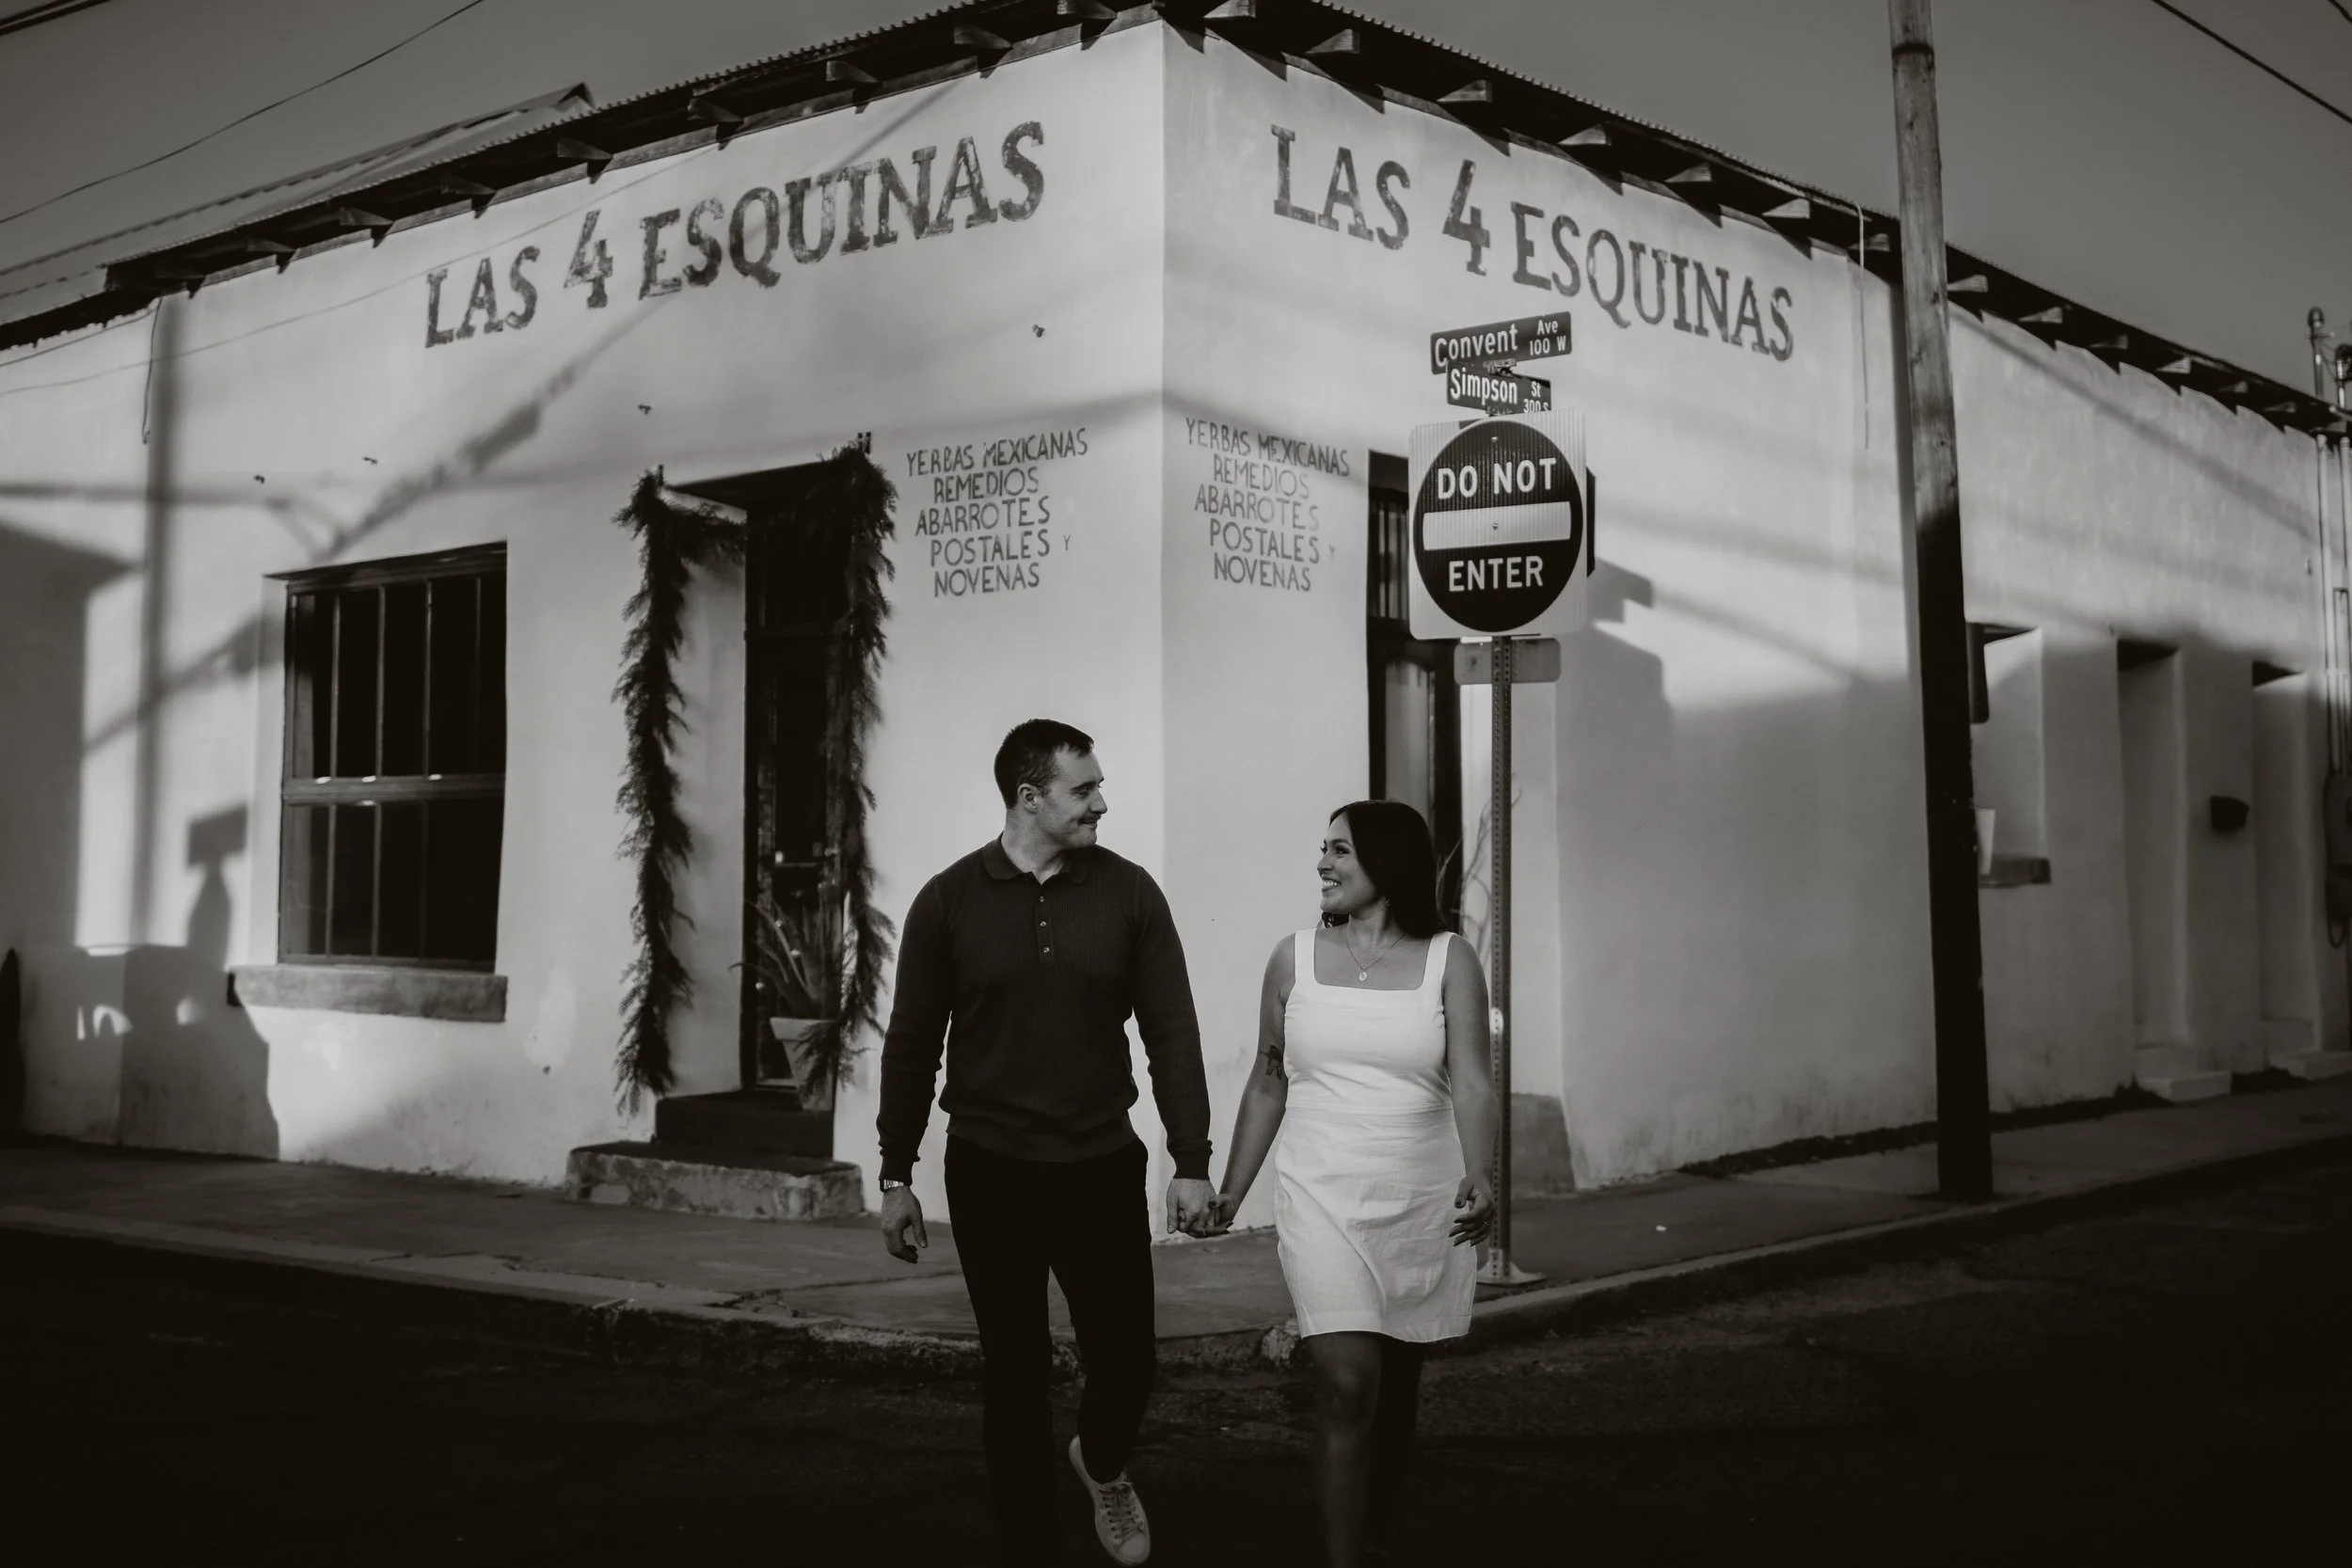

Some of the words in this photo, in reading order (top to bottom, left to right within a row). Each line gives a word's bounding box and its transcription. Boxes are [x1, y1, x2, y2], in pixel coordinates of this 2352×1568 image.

[425, 246, 540, 348] LAS
[564, 209, 613, 309] 4
[638, 120, 1044, 300] ESQUINAS
[1270, 124, 1410, 250] LAS
[1442, 159, 1490, 276] 4
[1510, 200, 1794, 361] ESQUINAS
[1435, 323, 1518, 367] Convent
[1536, 319, 1559, 336] Ave
[1529, 339, 1550, 356] 100
[1557, 335, 1566, 352] W
[1450, 368, 1518, 405] Simpson
[1531, 381, 1542, 397] St
[1523, 399, 1542, 413] 300
[906, 445, 975, 477] YERBAS
[982, 427, 1088, 468] MEXICANAS
[1185, 417, 1251, 457] YERBAS
[1257, 433, 1350, 477] MEXICANAS
[933, 467, 1040, 504] REMEDIOS
[1213, 452, 1310, 499] REMEDIOS
[1438, 465, 1478, 499] DO
[1493, 457, 1557, 495] NOT
[914, 495, 1050, 536] ABARROTES
[1194, 483, 1320, 531] ABARROTES
[930, 529, 1050, 566] POSTALES
[1210, 517, 1320, 564] POSTALES
[934, 562, 1040, 597] NOVENAS
[1214, 551, 1311, 592] NOVENAS
[1449, 555, 1544, 593] ENTER
